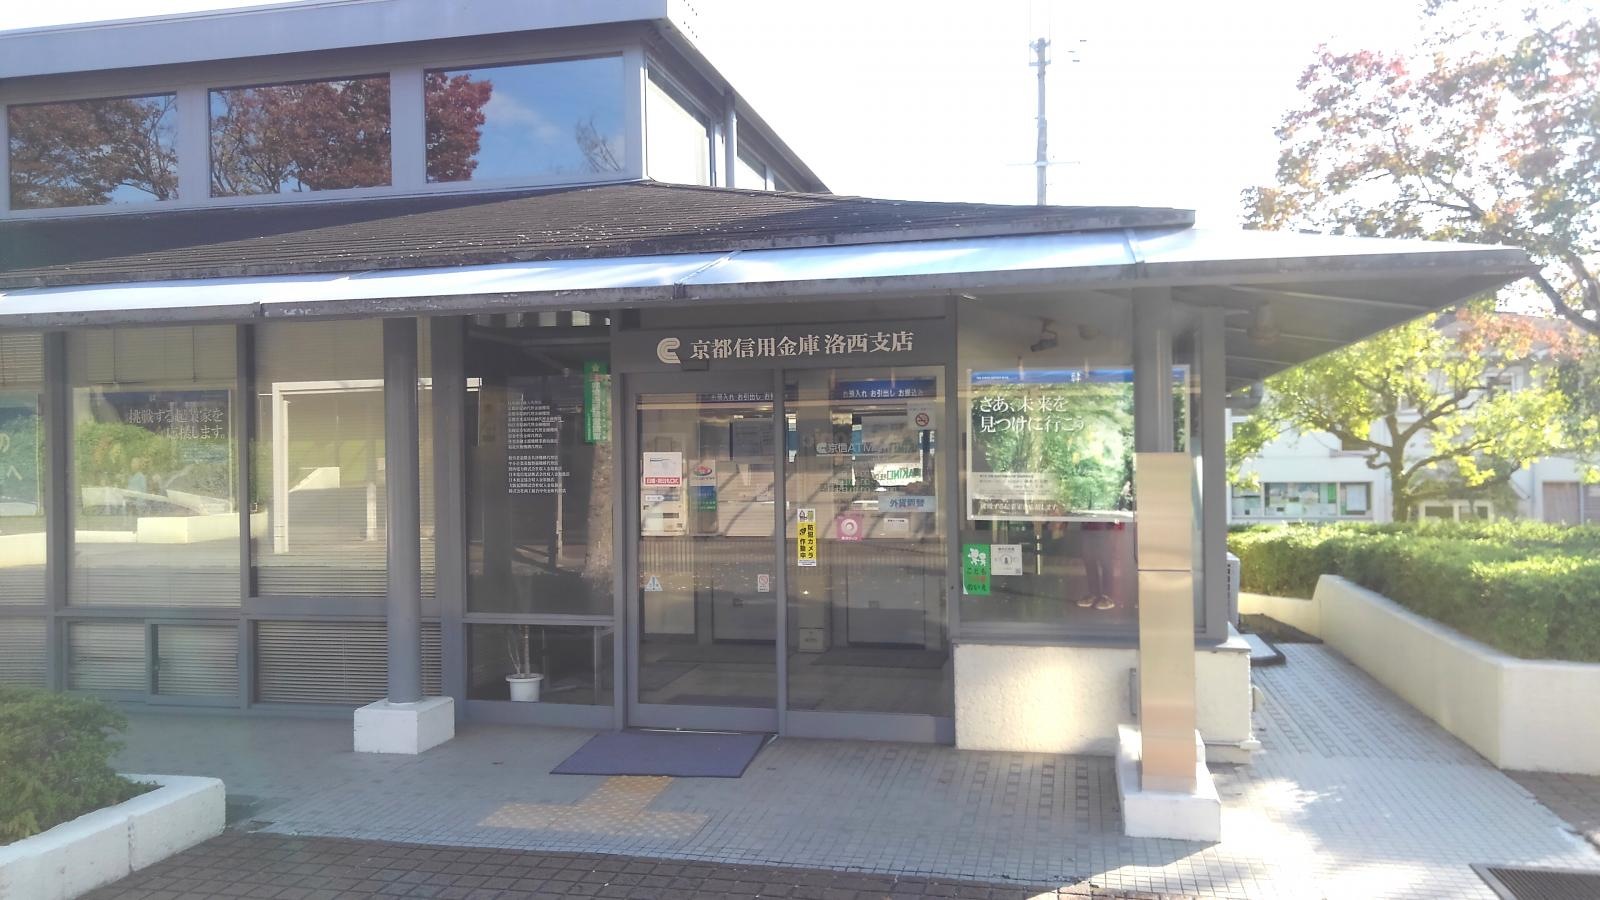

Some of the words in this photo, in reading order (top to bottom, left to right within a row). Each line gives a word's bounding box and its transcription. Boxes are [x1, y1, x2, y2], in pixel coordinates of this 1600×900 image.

[690, 336, 820, 360] 京都信用金庫
[824, 331, 914, 354] 洛西支店
[980, 415, 1085, 433] 見つけに行こう
